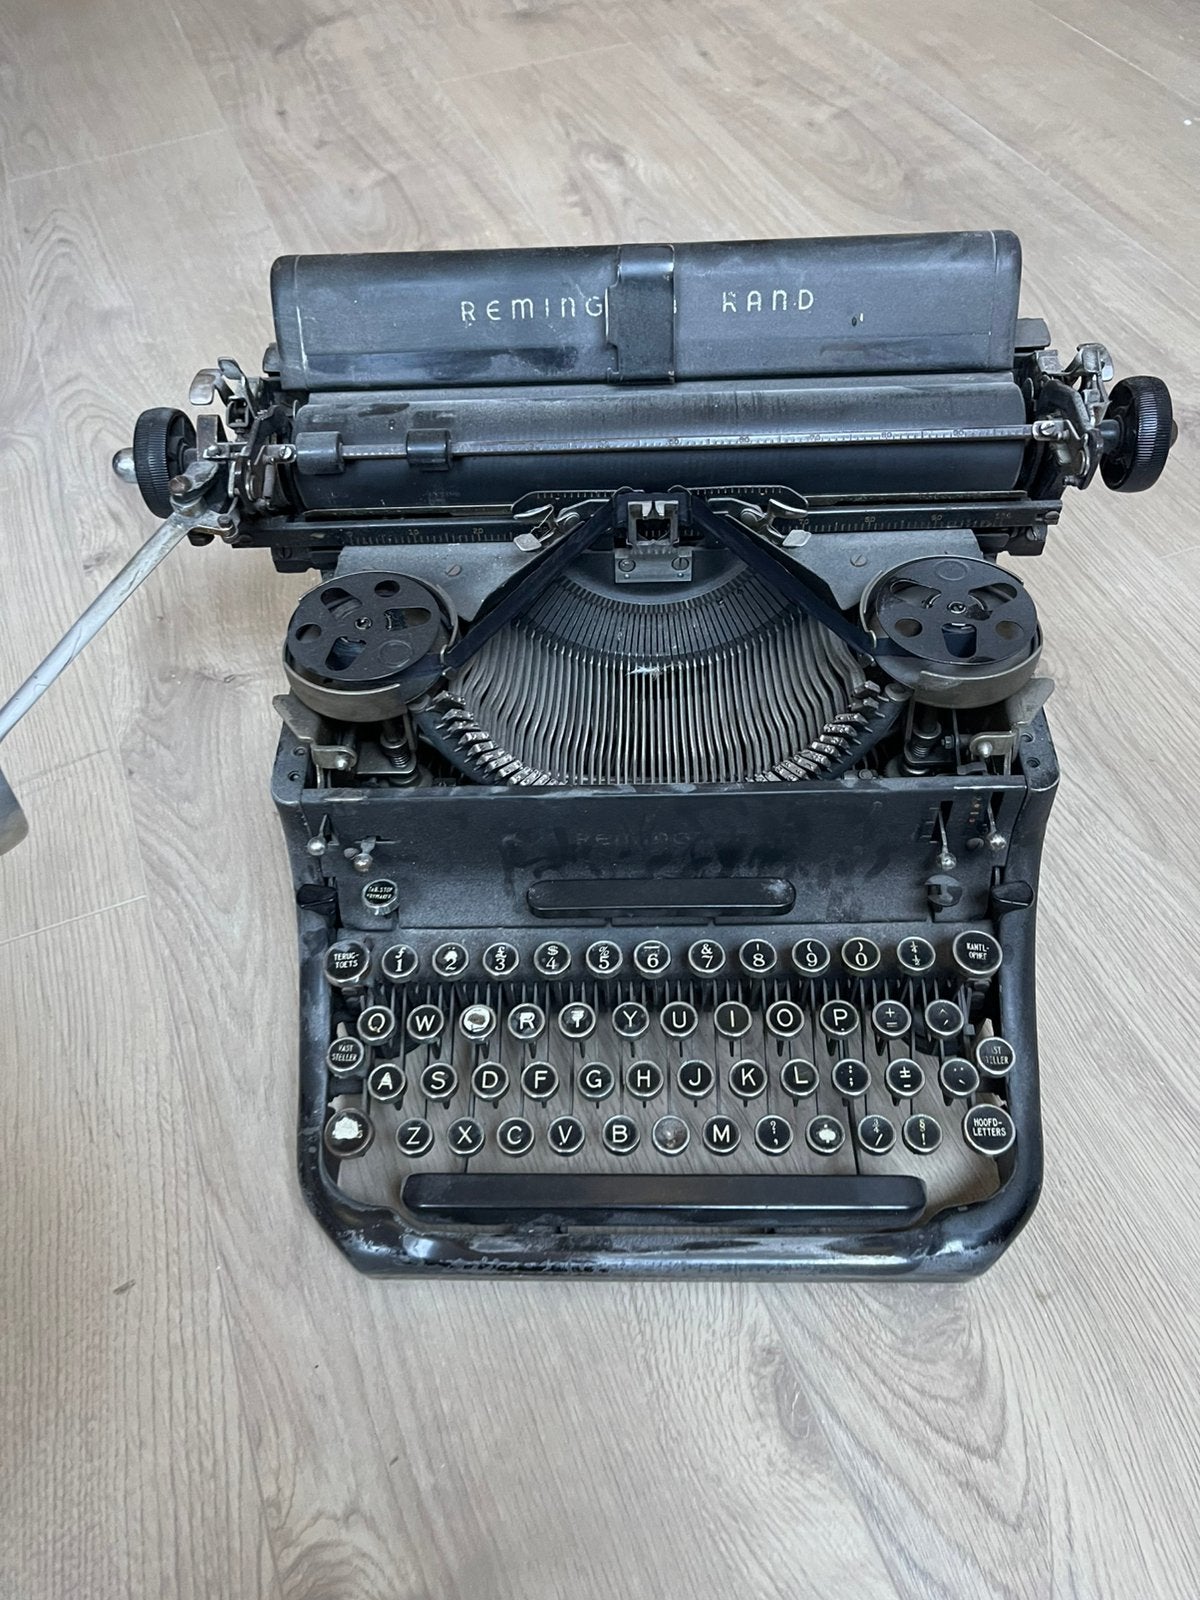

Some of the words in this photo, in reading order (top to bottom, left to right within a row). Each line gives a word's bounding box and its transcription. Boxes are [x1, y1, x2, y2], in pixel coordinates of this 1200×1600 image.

[548, 946, 558, 955] $
[599, 945, 609, 957] %
[701, 944, 712, 956] &
[396, 959, 402, 971] 1
[444, 958, 456, 970] 2
[495, 957, 505, 970] 3
[546, 957, 557, 969] 4
[599, 955, 611, 970] 5
[647, 953, 658, 967] 6
[700, 955, 713, 969] 7
[753, 954, 765, 966] 8
[806, 953, 817, 966] 9
[368, 1013, 385, 1032] Q
[416, 1015, 436, 1033] W
[518, 1012, 535, 1031] R
[623, 1011, 637, 1027] Y
[673, 1011, 686, 1028] U
[731, 1010, 734, 1027] I
[777, 1009, 793, 1027] O
[834, 1009, 847, 1026] P
[378, 1072, 392, 1089] A
[431, 1071, 445, 1089] S
[482, 1071, 498, 1088] D
[535, 1071, 547, 1088] F
[586, 1070, 601, 1088] G
[638, 1070, 650, 1087] H
[689, 1068, 700, 1086] J
[742, 1068, 755, 1086] K
[794, 1066, 808, 1083] L
[973, 1117, 1003, 1127] HOOFD-
[407, 1127, 421, 1144] Z
[458, 1126, 472, 1144] X
[507, 1126, 521, 1144] C
[559, 1126, 572, 1145] V
[613, 1125, 627, 1142] B
[714, 1124, 729, 1142] M
[973, 1126, 1007, 1137] LETTERS
